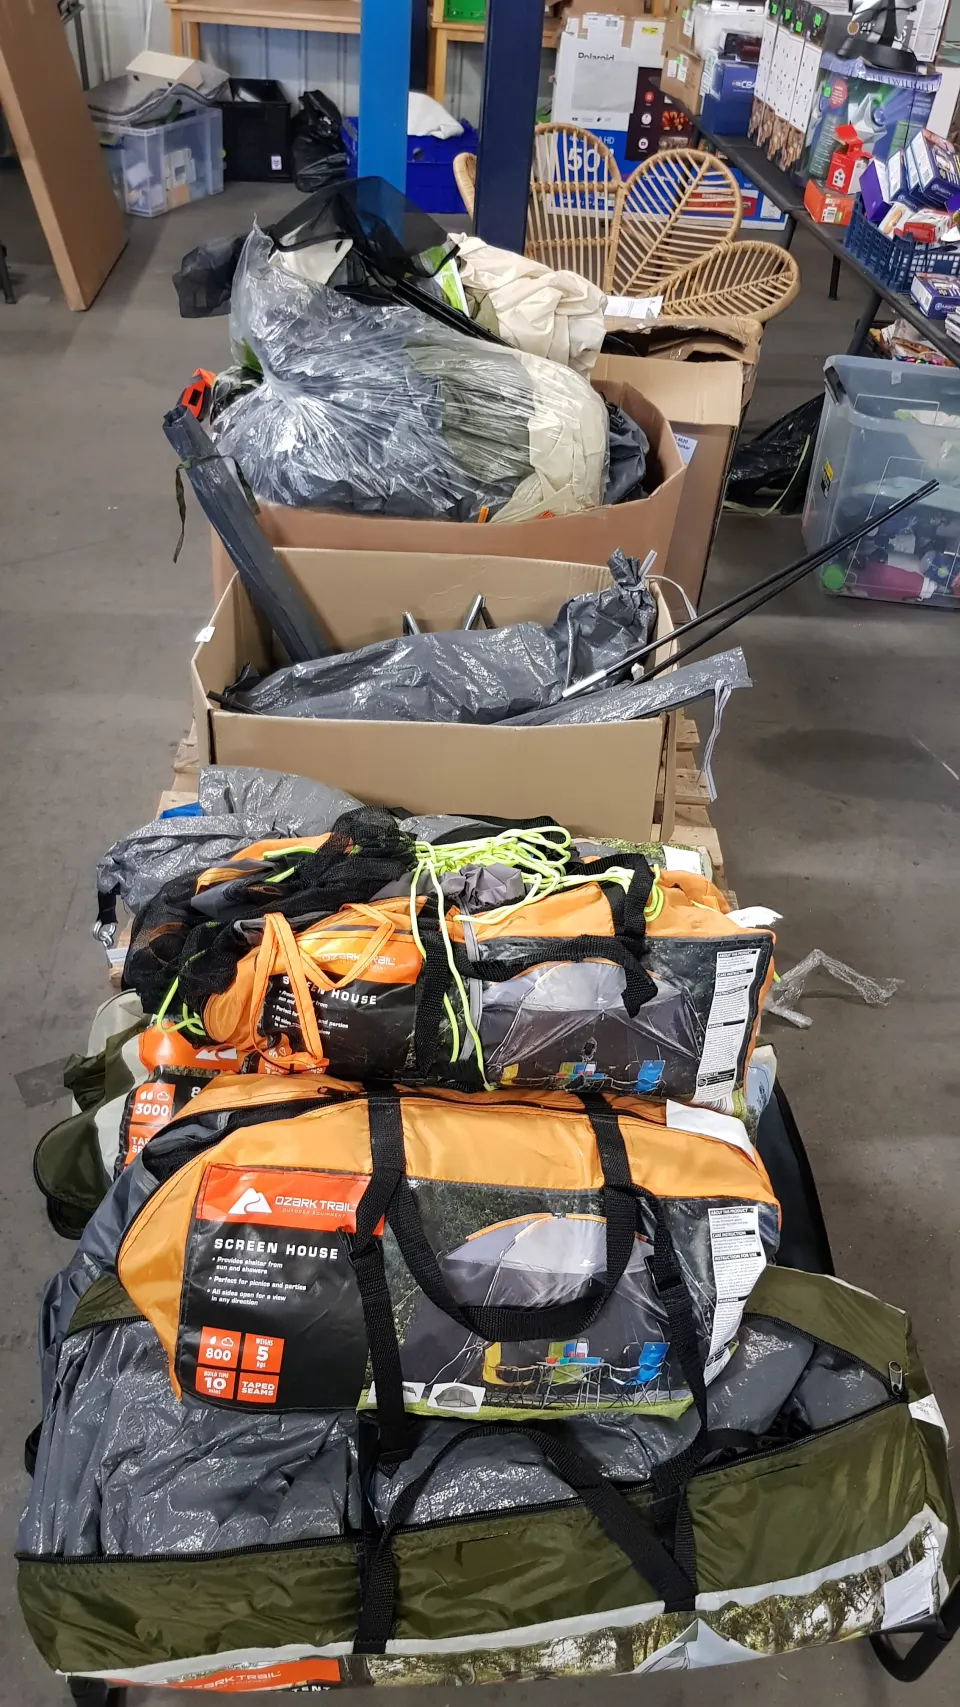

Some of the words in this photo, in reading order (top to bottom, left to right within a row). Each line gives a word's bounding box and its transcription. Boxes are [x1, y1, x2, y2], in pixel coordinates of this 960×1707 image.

[331, 988, 377, 1005] HOUSE
[135, 1102, 169, 1117] 3000
[275, 1195, 319, 1209] OZARK
[318, 1200, 356, 1213] TRAIL
[214, 1238, 278, 1254] SCREEN
[285, 1244, 339, 1260] HOUSE
[216, 1256, 244, 1265] Provides
[244, 1258, 267, 1267] shelter
[267, 1261, 283, 1269] from
[241, 1266, 268, 1274] showers
[213, 1275, 237, 1284] Perfect
[249, 1279, 270, 1288] picnics
[284, 1282, 307, 1291] parties
[221, 1289, 238, 1297] sides
[239, 1292, 255, 1300] open
[231, 1298, 259, 1306] direction
[205, 1347, 232, 1361] 800
[256, 1346, 269, 1362] 5
[256, 1361, 267, 1369] kgs
[204, 1377, 227, 1390] 10
[241, 1381, 275, 1390] TAPED
[241, 1387, 274, 1396] SEAMS
[235, 1671, 282, 1680] TRAIL
